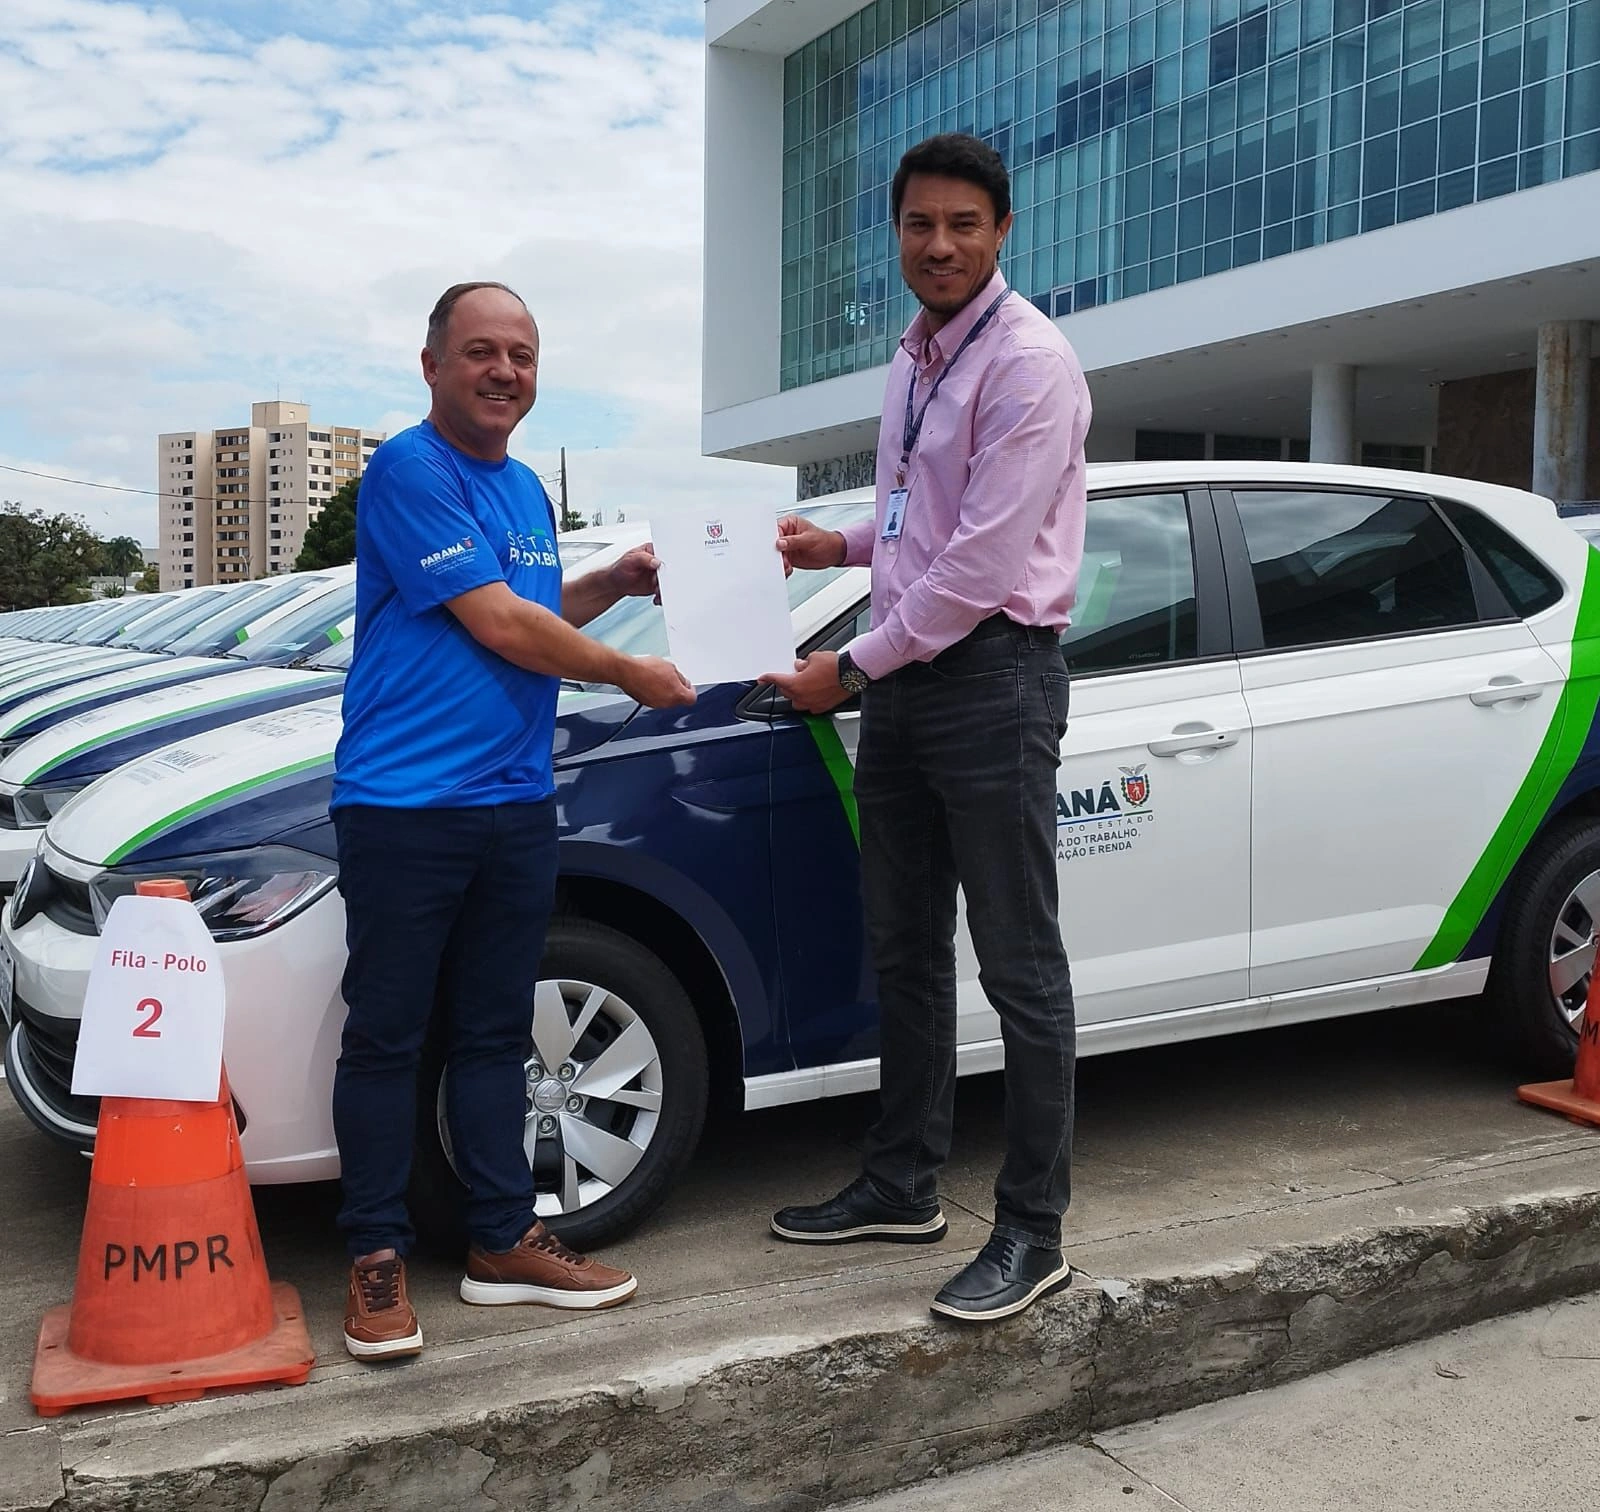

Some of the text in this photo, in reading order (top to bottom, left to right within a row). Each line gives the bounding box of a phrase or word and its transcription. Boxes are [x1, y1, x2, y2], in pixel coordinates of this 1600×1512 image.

[1056, 781, 1121, 818] ANÁ
[1068, 815, 1154, 834] DO ESTADO
[1066, 836, 1081, 847] DO
[1084, 828, 1141, 844] TRABALHO,
[1058, 841, 1132, 861] AÇÃO E RENDA
[111, 950, 146, 969] Fila
[164, 953, 207, 973] Polo
[132, 997, 163, 1038] 2
[104, 1234, 235, 1282] PMPR
